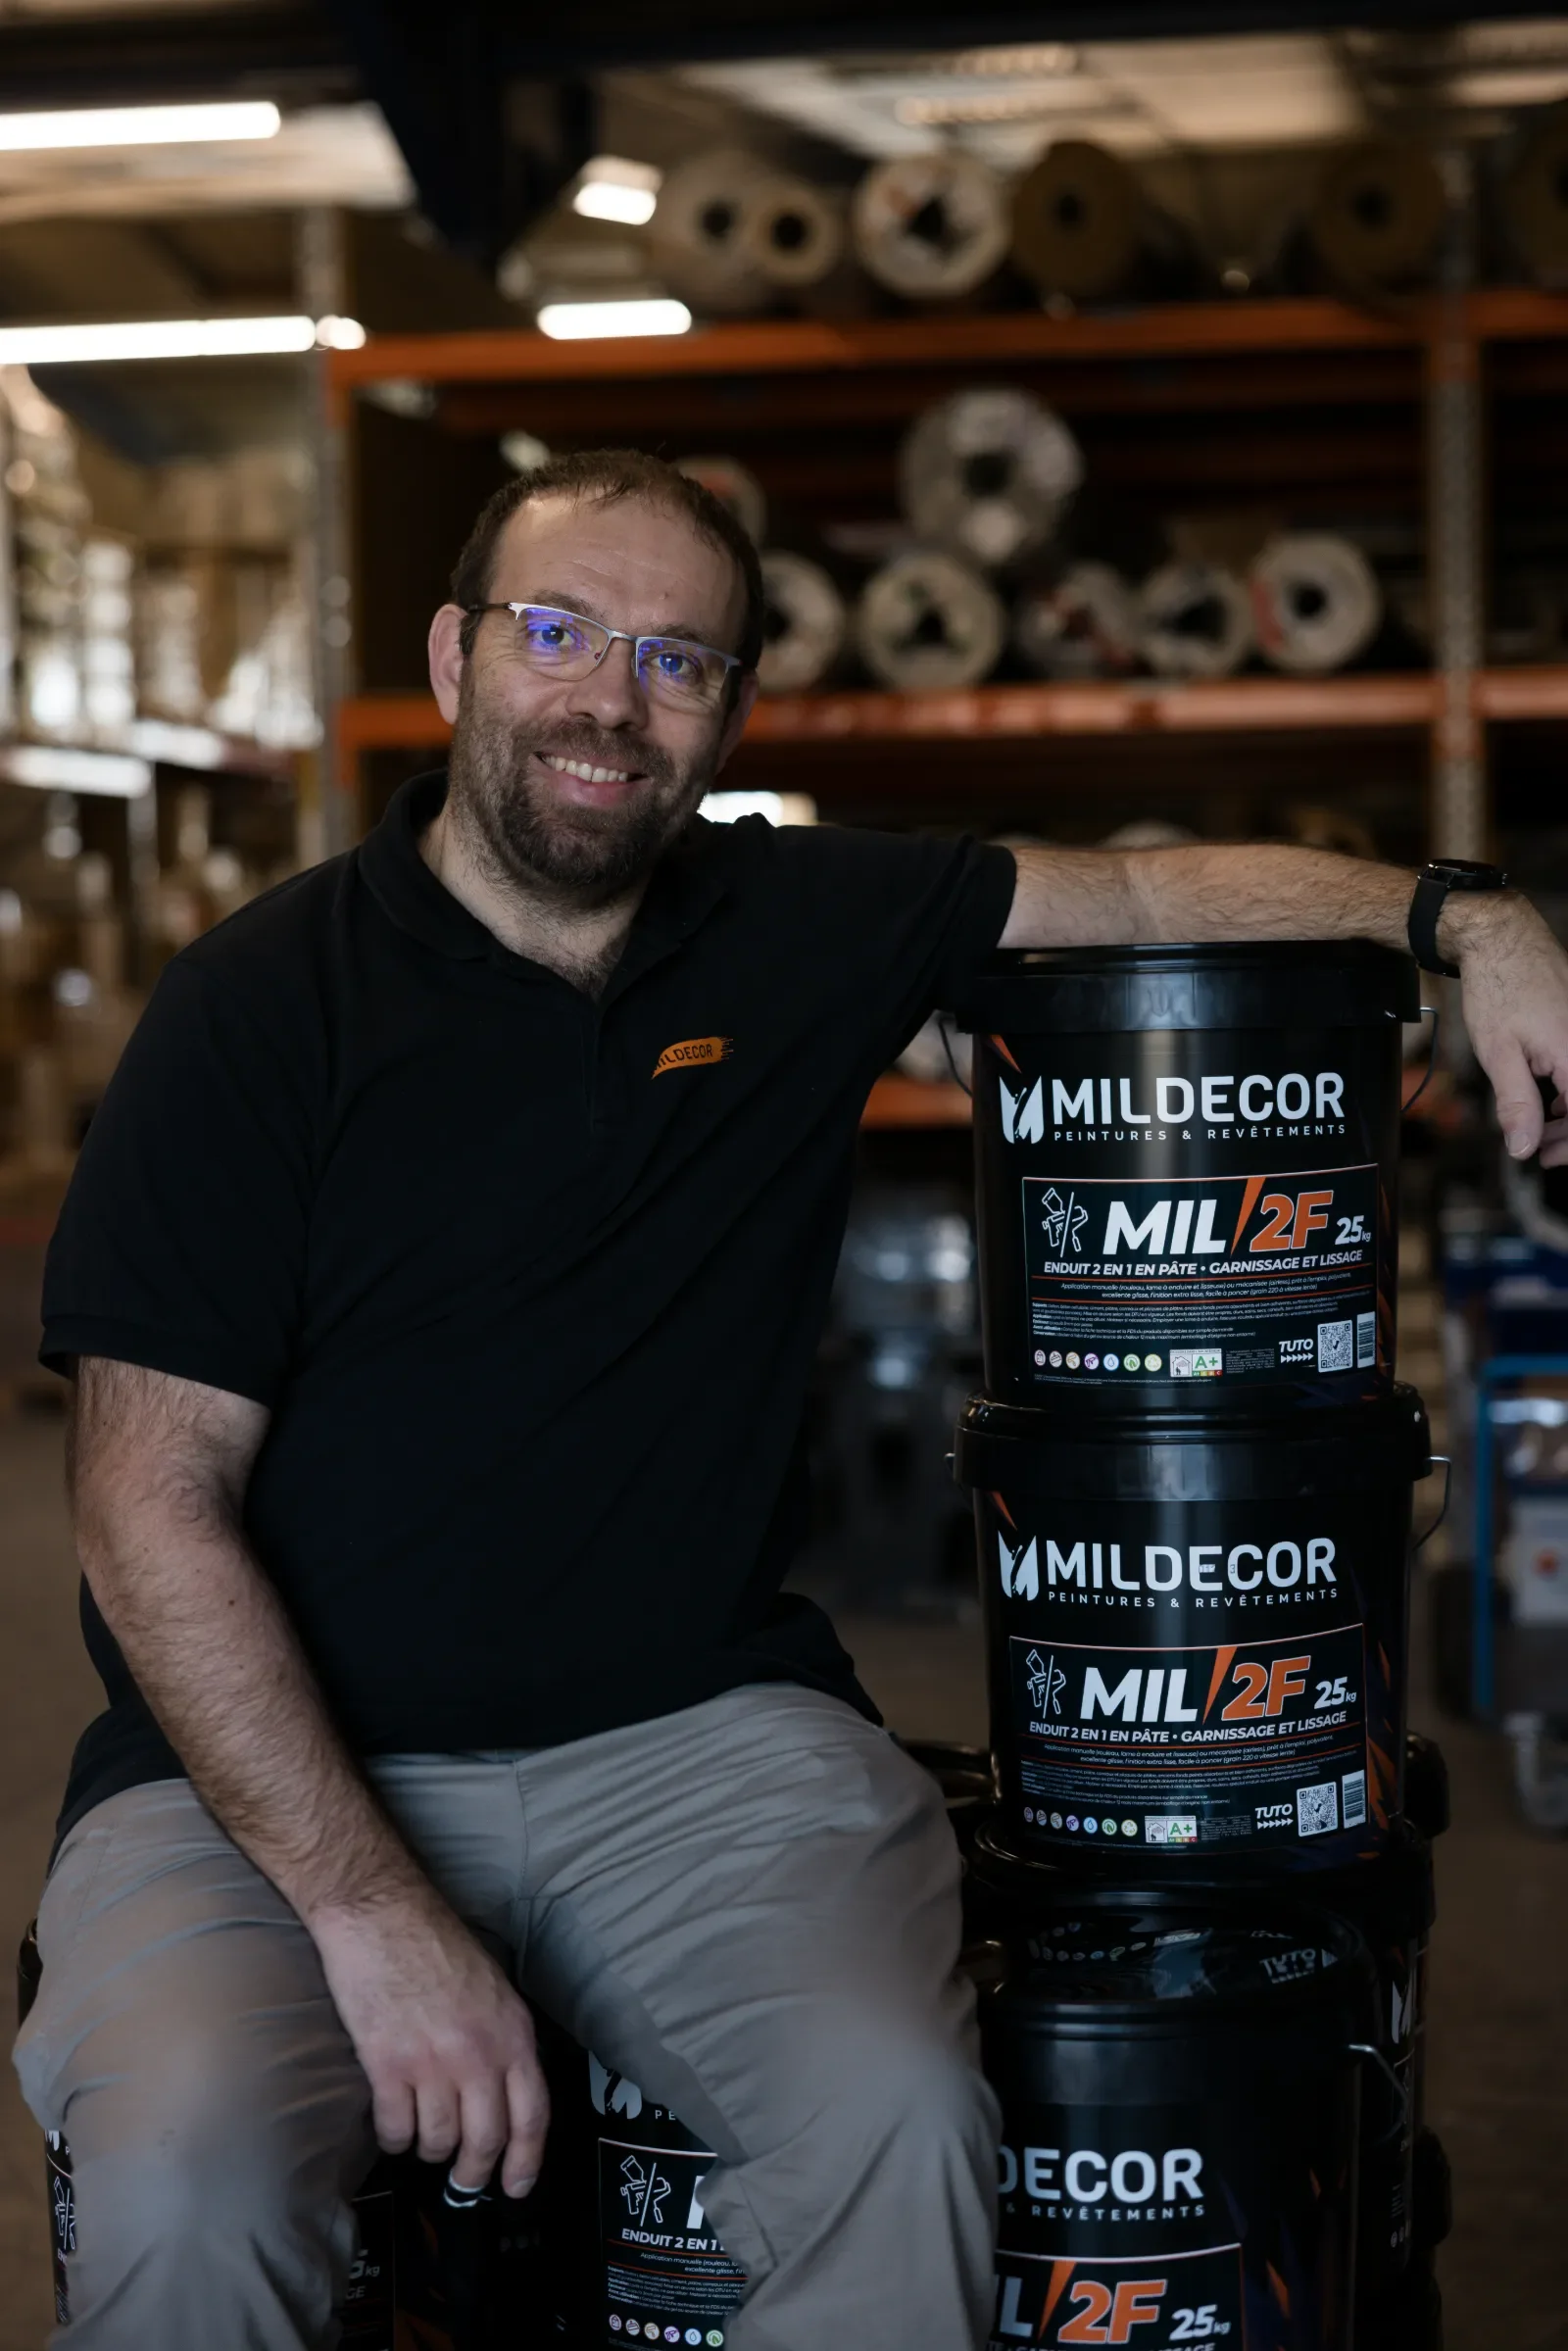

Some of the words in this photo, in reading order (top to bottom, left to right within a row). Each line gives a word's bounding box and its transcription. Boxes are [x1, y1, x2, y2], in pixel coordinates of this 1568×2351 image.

[1052, 1071, 1346, 1125] MILDECOR
[1054, 1130, 1167, 1142] PEINTURES
[1182, 1130, 1192, 1140] &
[1207, 1124, 1346, 1140] REVÊTEMENTS
[1102, 1199, 1228, 1255] MIL
[1249, 1189, 1335, 1252] 2F
[1044, 1261, 1092, 1274] ENDUIT
[1092, 1263, 1101, 1275] 2
[1102, 1263, 1125, 1276] EN
[1126, 1263, 1133, 1276] 1
[1135, 1263, 1157, 1275] EN
[1158, 1260, 1198, 1276] PÂTE
[1209, 1256, 1299, 1274] GARNISSAGE
[1301, 1255, 1319, 1268] ET
[1319, 1249, 1363, 1266] LISSAGE
[1278, 1338, 1314, 1353] TUTO
[1194, 1354, 1218, 1369] A+
[1046, 1537, 1337, 1592] MILDECOR
[1048, 1592, 1155, 1607] PEINTURES
[1170, 1597, 1180, 1608] &
[1196, 1588, 1338, 1608] REVÊTEMENTS
[1079, 1666, 1199, 1723] MIL
[1221, 1654, 1311, 1722] 2F
[1029, 1721, 1070, 1738] ENDUIT
[1070, 1727, 1079, 1739] 2
[1081, 1728, 1101, 1740] EN
[1101, 1729, 1107, 1741] 1
[1109, 1730, 1129, 1742] EN
[1132, 1728, 1169, 1743] PÂTE
[1181, 1725, 1275, 1742] GARNISSAGE
[1278, 1721, 1297, 1735] ET
[1298, 1711, 1348, 1732] LISSAGE
[1254, 1803, 1294, 1821] TUTO
[1169, 1822, 1193, 1836] A+
[1031, 2203, 1205, 2223] REVÊTEMENTS
[621, 2228, 673, 2247] ENDUIT
[674, 2236, 685, 2248] 2
[686, 2238, 709, 2251] EN
[1057, 2278, 1169, 2345] 2F
